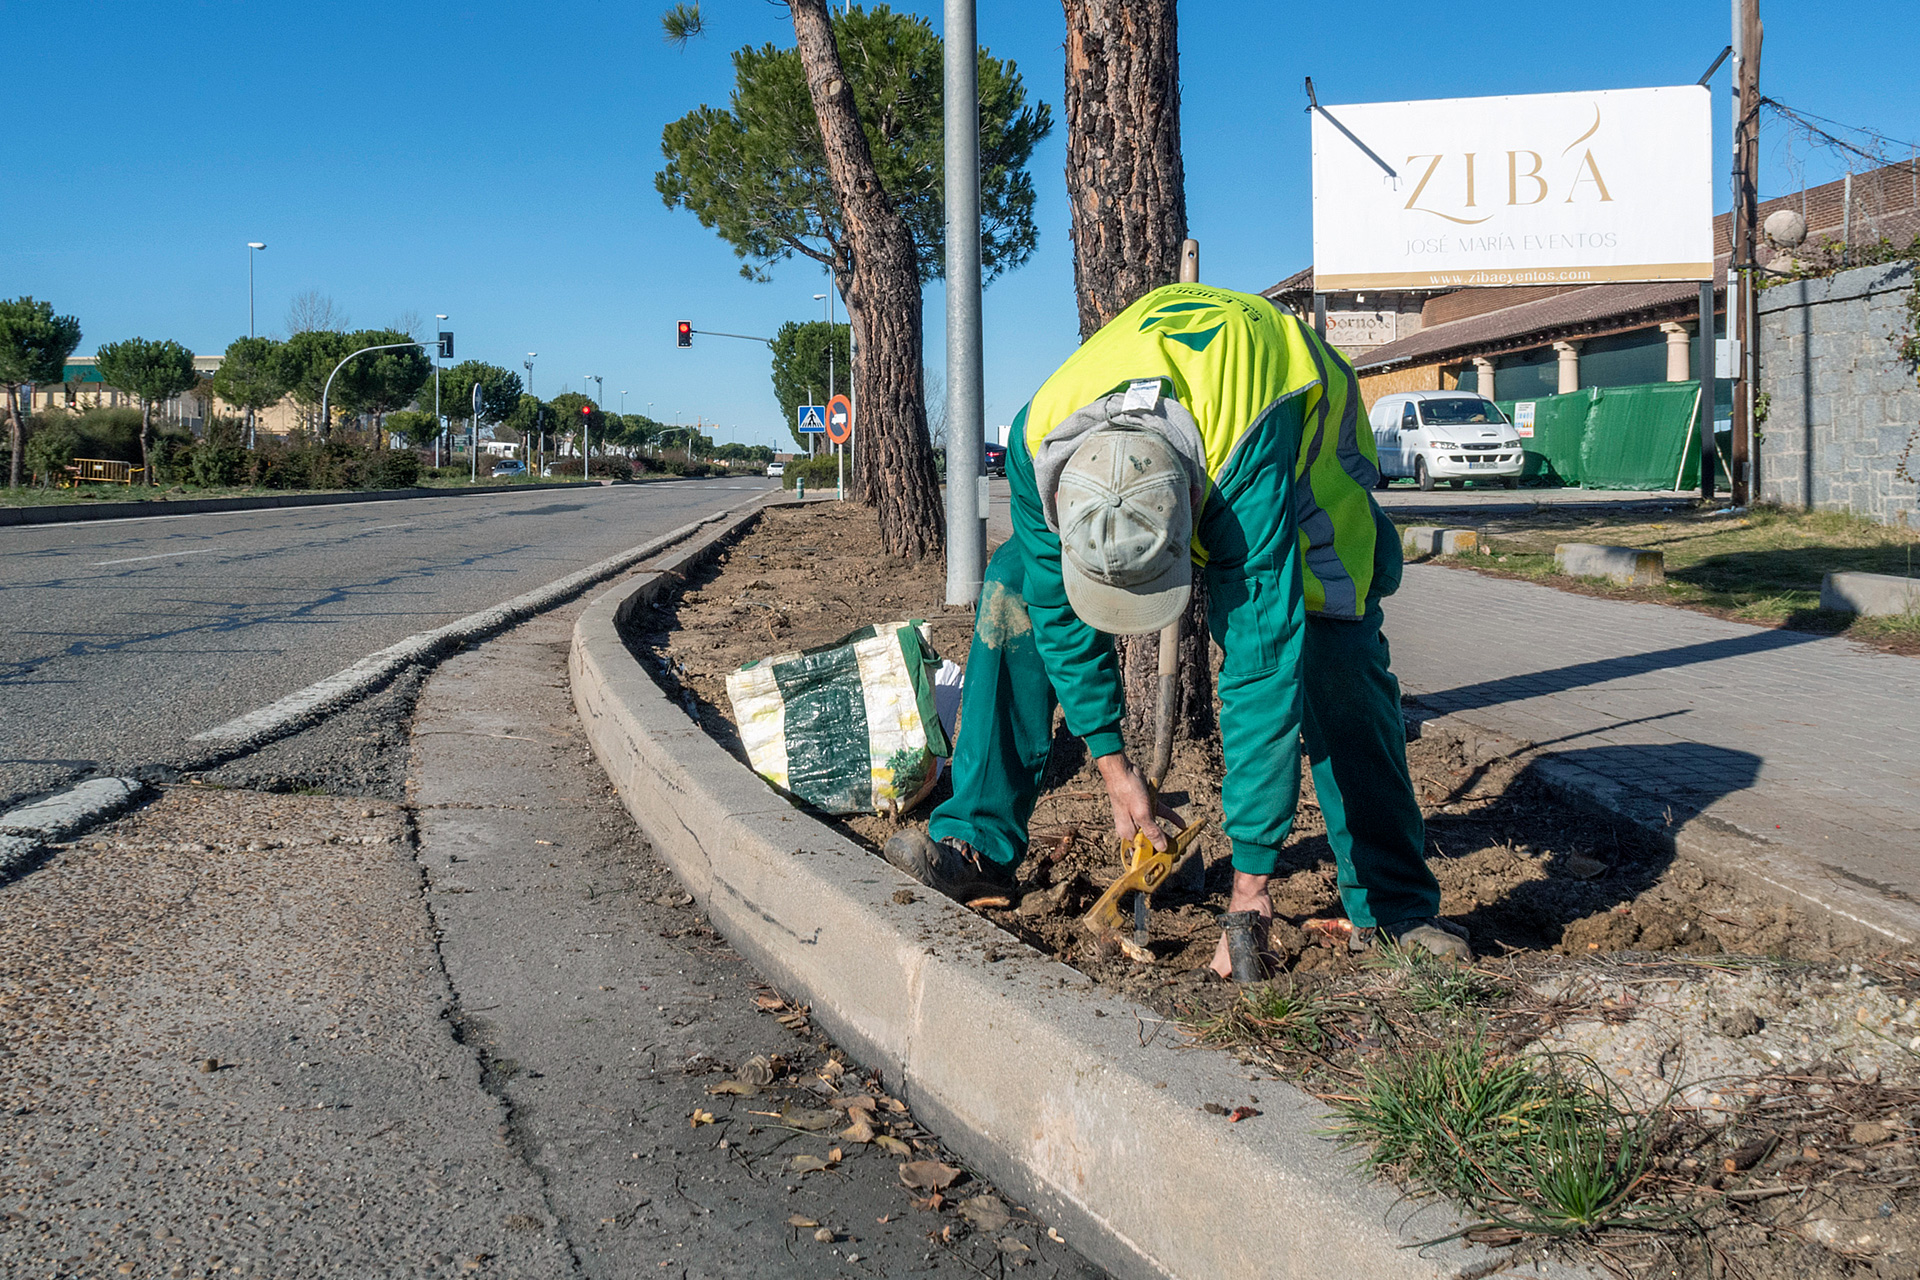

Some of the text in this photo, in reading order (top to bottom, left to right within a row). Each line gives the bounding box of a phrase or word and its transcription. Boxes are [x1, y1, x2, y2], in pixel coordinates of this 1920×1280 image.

[1405, 232, 1618, 257] JOSÉ MARÍA EVENTOS
[1429, 269, 1592, 285] www.zibaeventos.com
